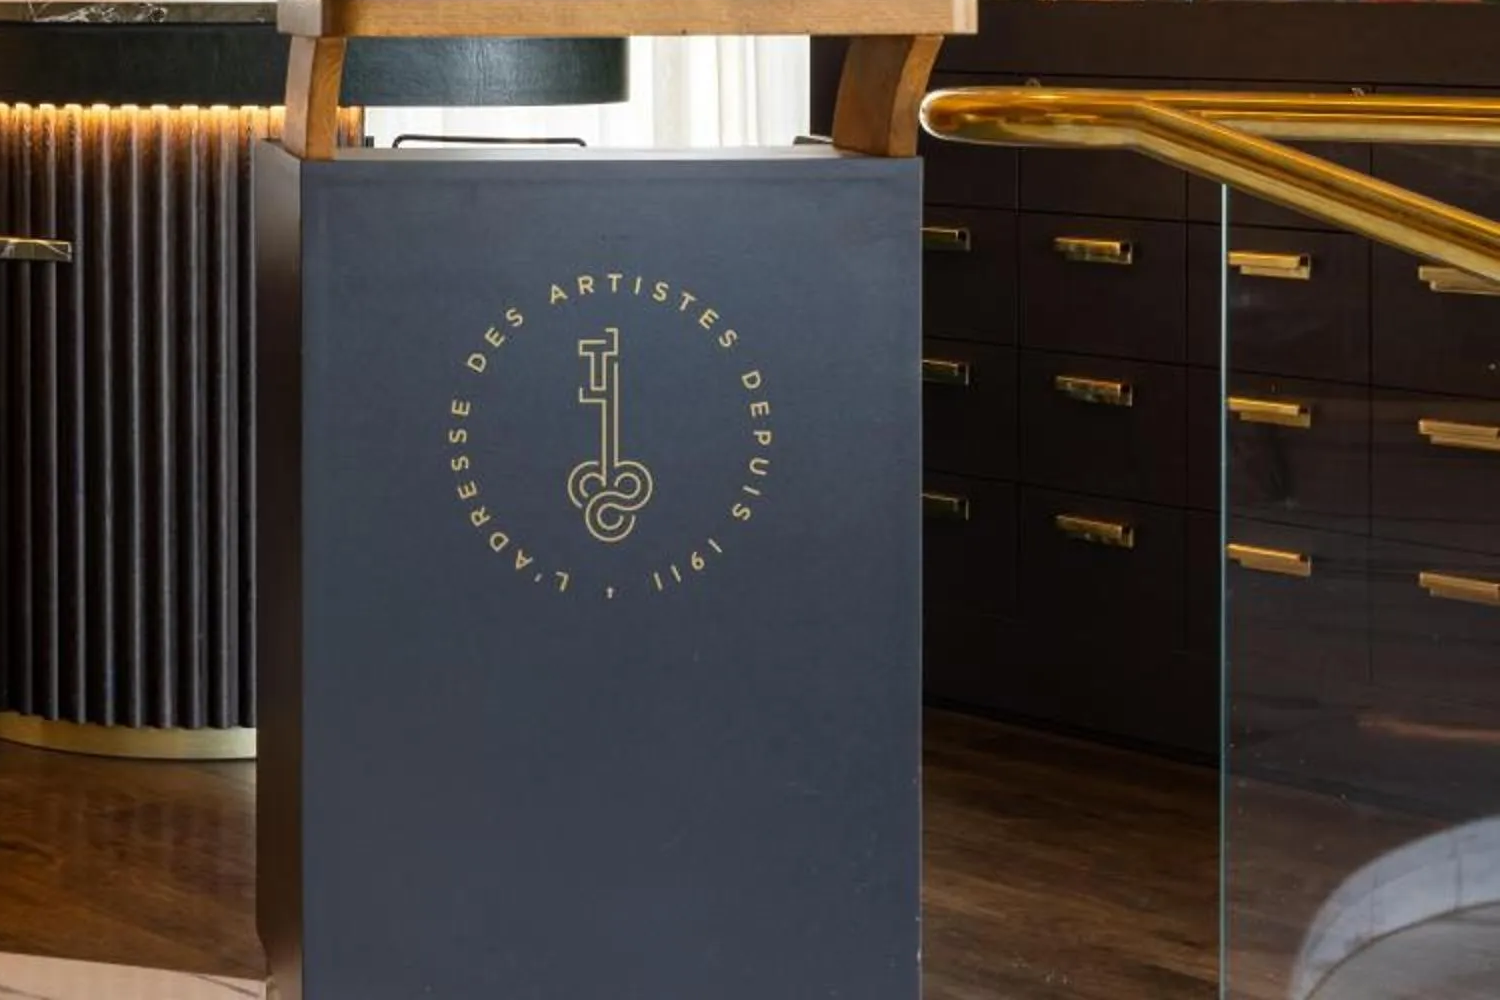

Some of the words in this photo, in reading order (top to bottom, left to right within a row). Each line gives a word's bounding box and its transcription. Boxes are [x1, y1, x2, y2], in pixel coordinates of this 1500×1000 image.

[465, 307, 524, 373] DES
[549, 273, 738, 348] ARTISTES
[731, 369, 772, 521] DEPUIS
[448, 399, 570, 593] L'ADRESSE
[653, 538, 723, 591] 1911
